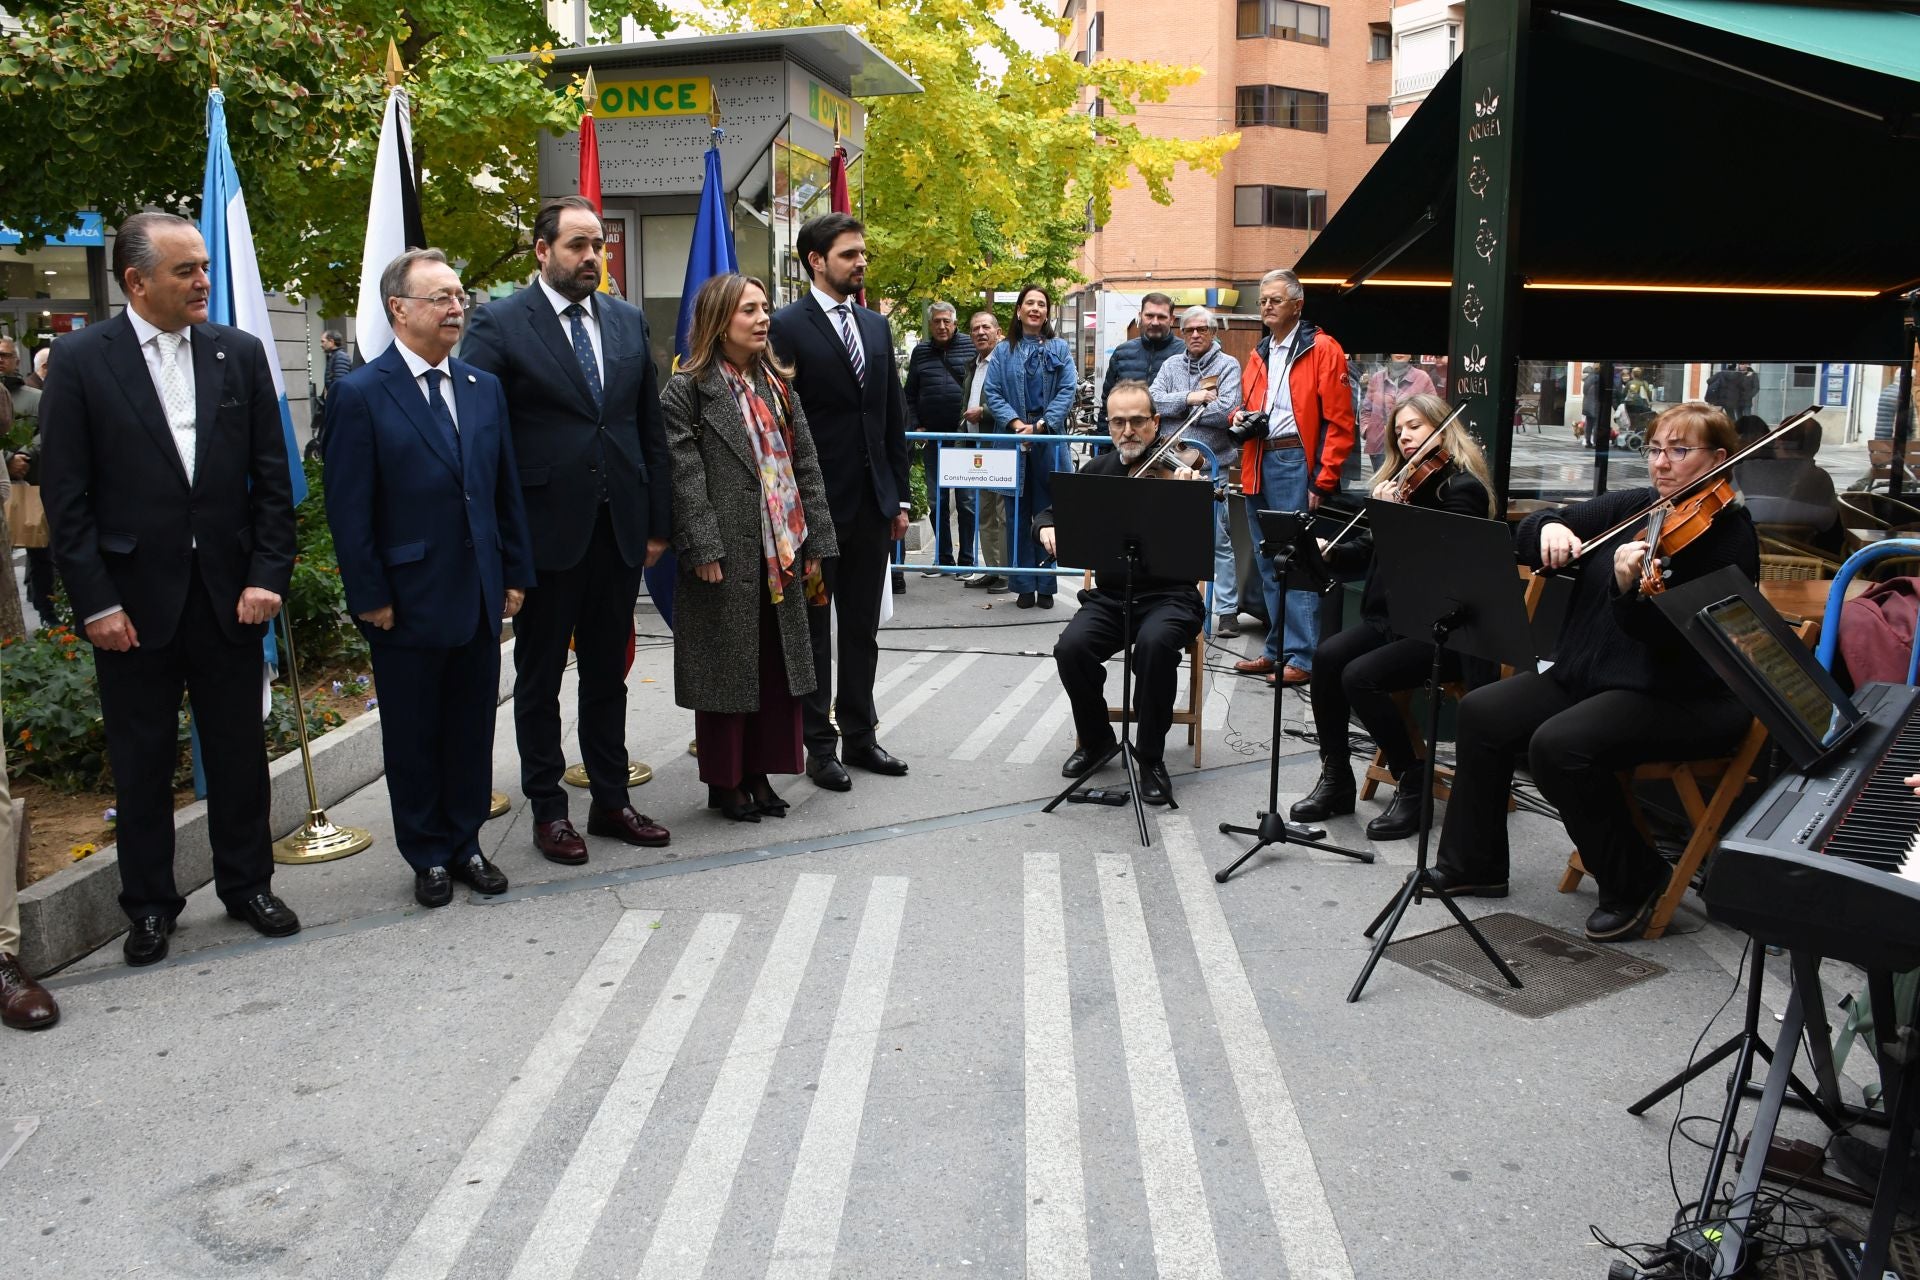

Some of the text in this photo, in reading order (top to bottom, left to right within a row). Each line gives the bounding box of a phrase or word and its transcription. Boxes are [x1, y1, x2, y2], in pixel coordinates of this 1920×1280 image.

[600, 83, 697, 113] ONCE
[68, 228, 99, 237] PLAZA
[943, 474, 987, 482] Construyendo
